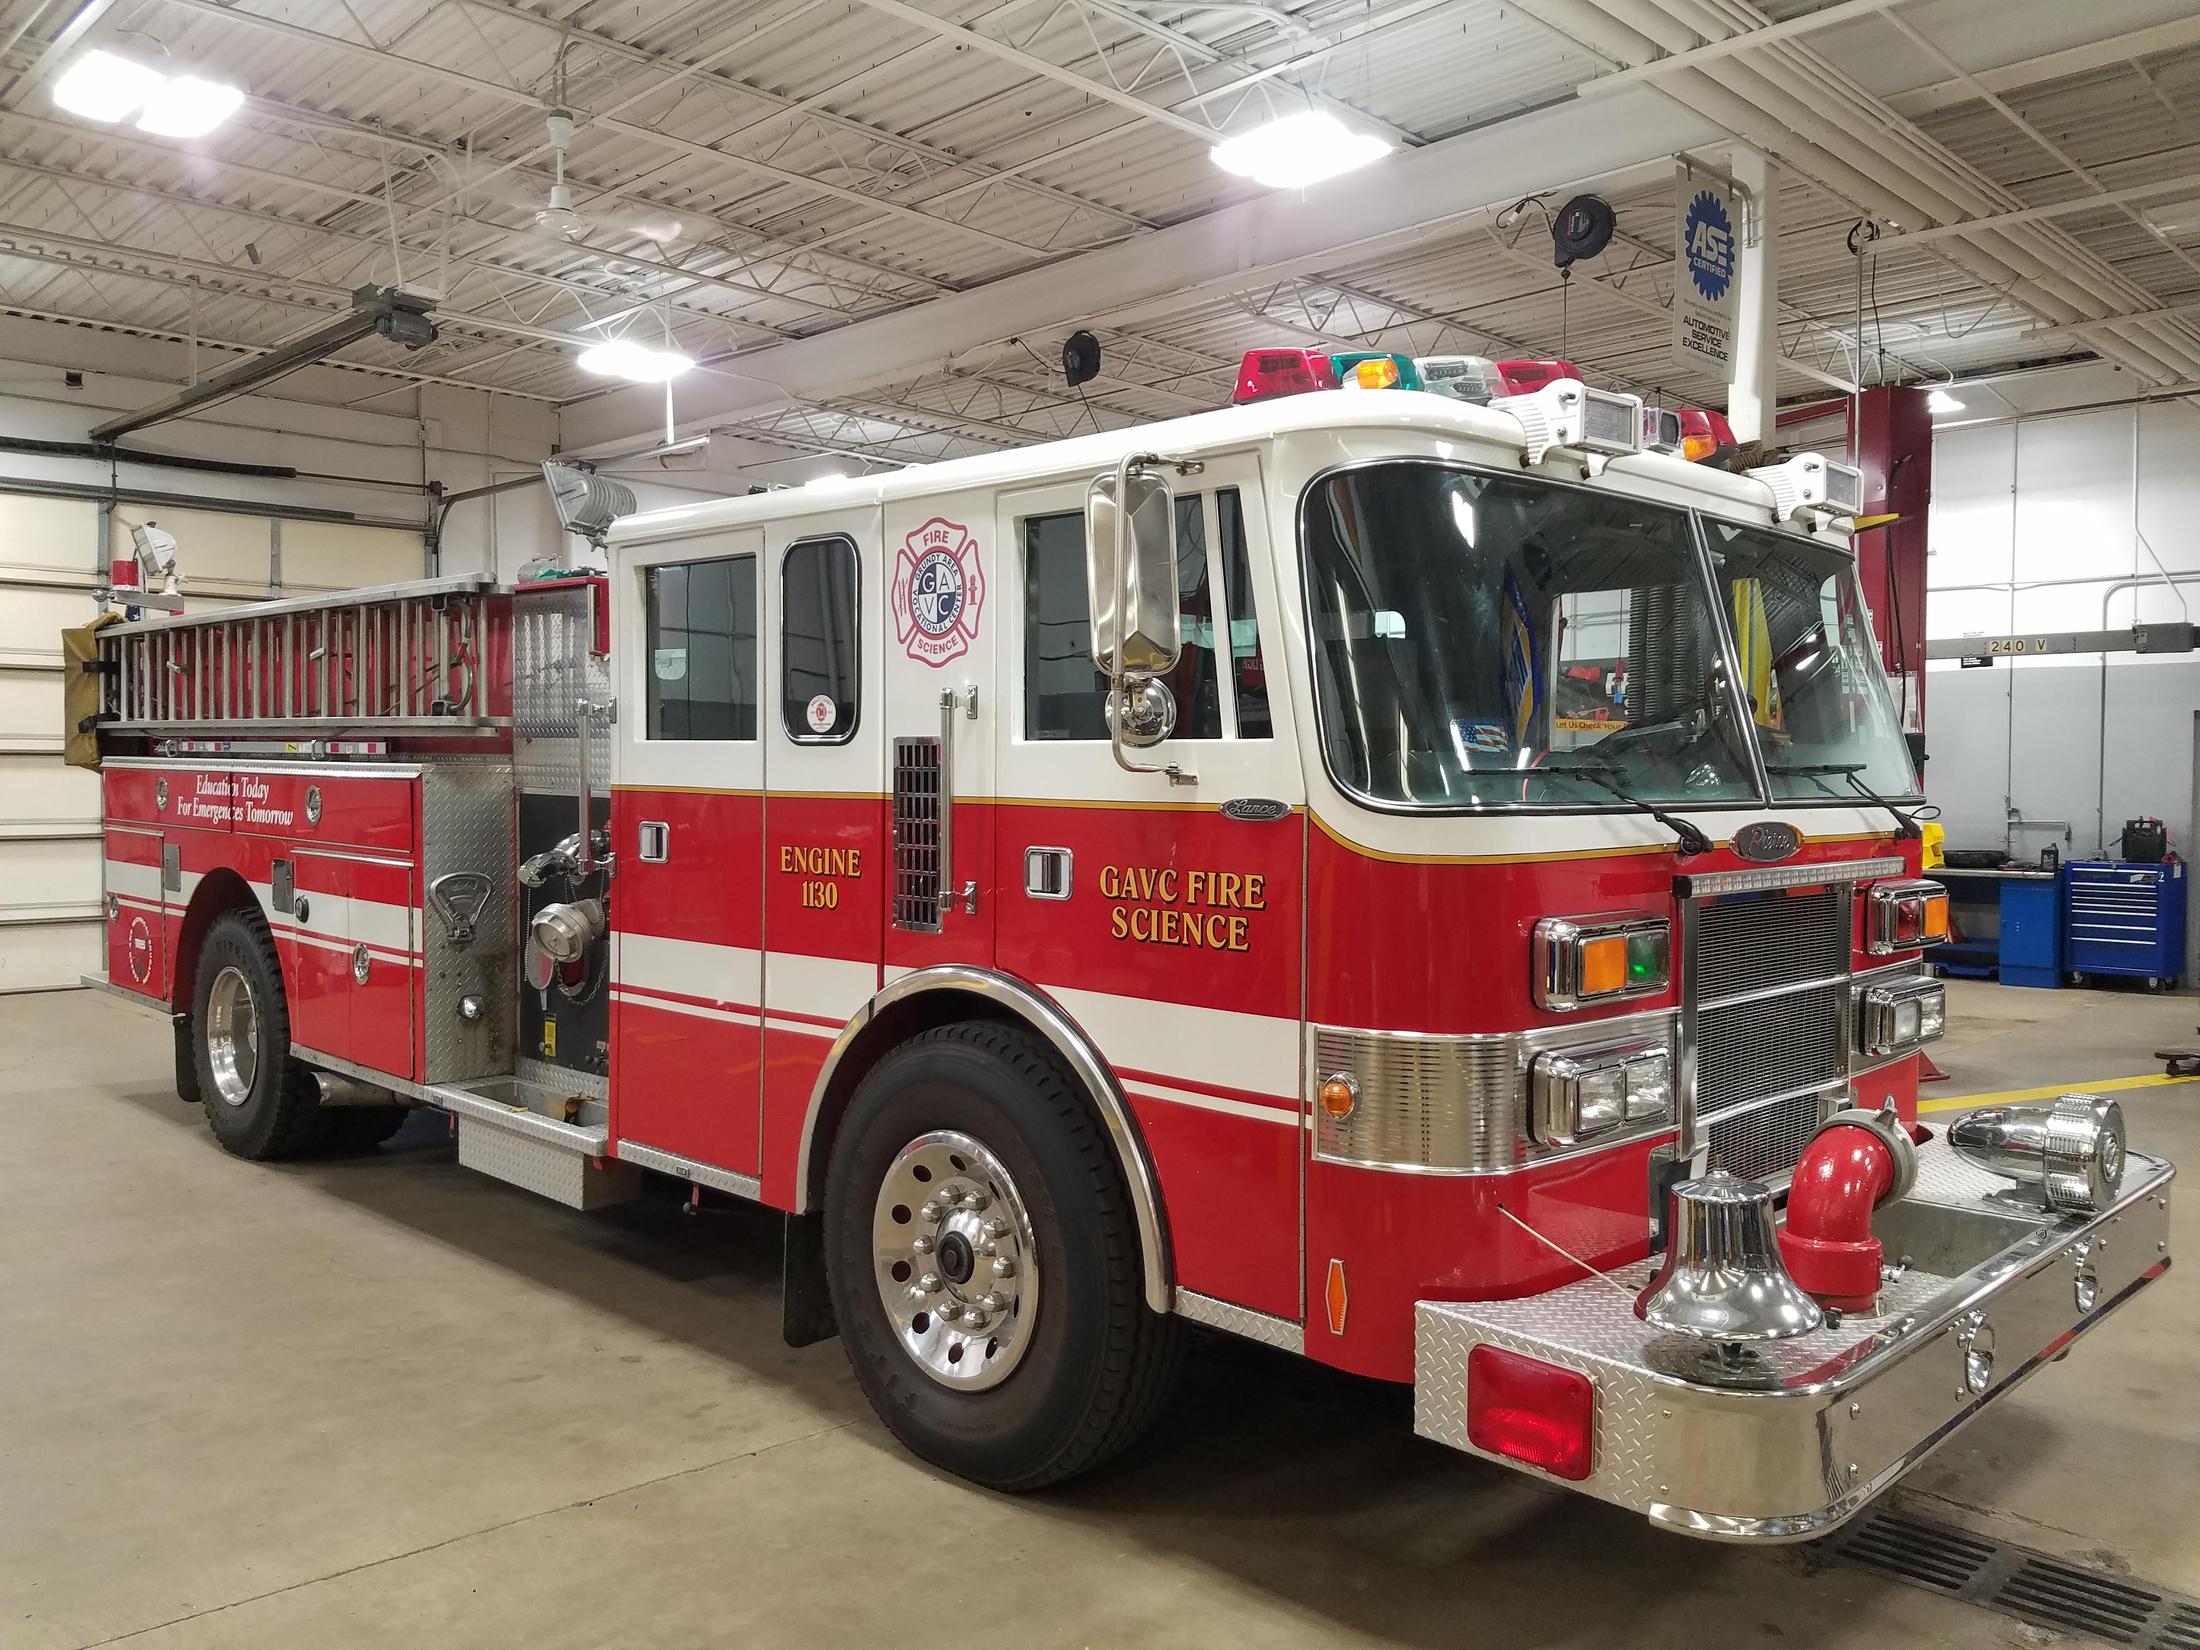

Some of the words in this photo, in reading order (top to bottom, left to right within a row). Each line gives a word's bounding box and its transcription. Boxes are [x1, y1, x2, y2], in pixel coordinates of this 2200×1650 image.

[1691, 220, 1728, 267] ASE
[1693, 257, 1728, 278] CERTIFIED
[1682, 315, 1731, 341] AUTOMOTIVE
[1691, 329, 1722, 348] SERVICE
[1682, 337, 1729, 362] EXCELLENCE
[922, 530, 950, 547] FIRE
[915, 553, 940, 581] GRUNDY
[942, 555, 958, 577] AREA
[912, 589, 948, 633] VOCATIONAL
[948, 584, 962, 623] CENTER
[916, 634, 959, 655] SCIENCE
[1991, 640, 2024, 652] 240
[2037, 639, 2046, 651] V
[196, 774, 239, 797] Education
[241, 776, 270, 804] Today
[177, 796, 192, 816] For
[245, 801, 294, 826] Tomorrow
[780, 846, 862, 879] ENGINE
[802, 880, 839, 911] 1130
[1099, 865, 1179, 903] GAVC
[1187, 870, 1268, 911] FIRE
[1111, 905, 1251, 953] SCIENCE
